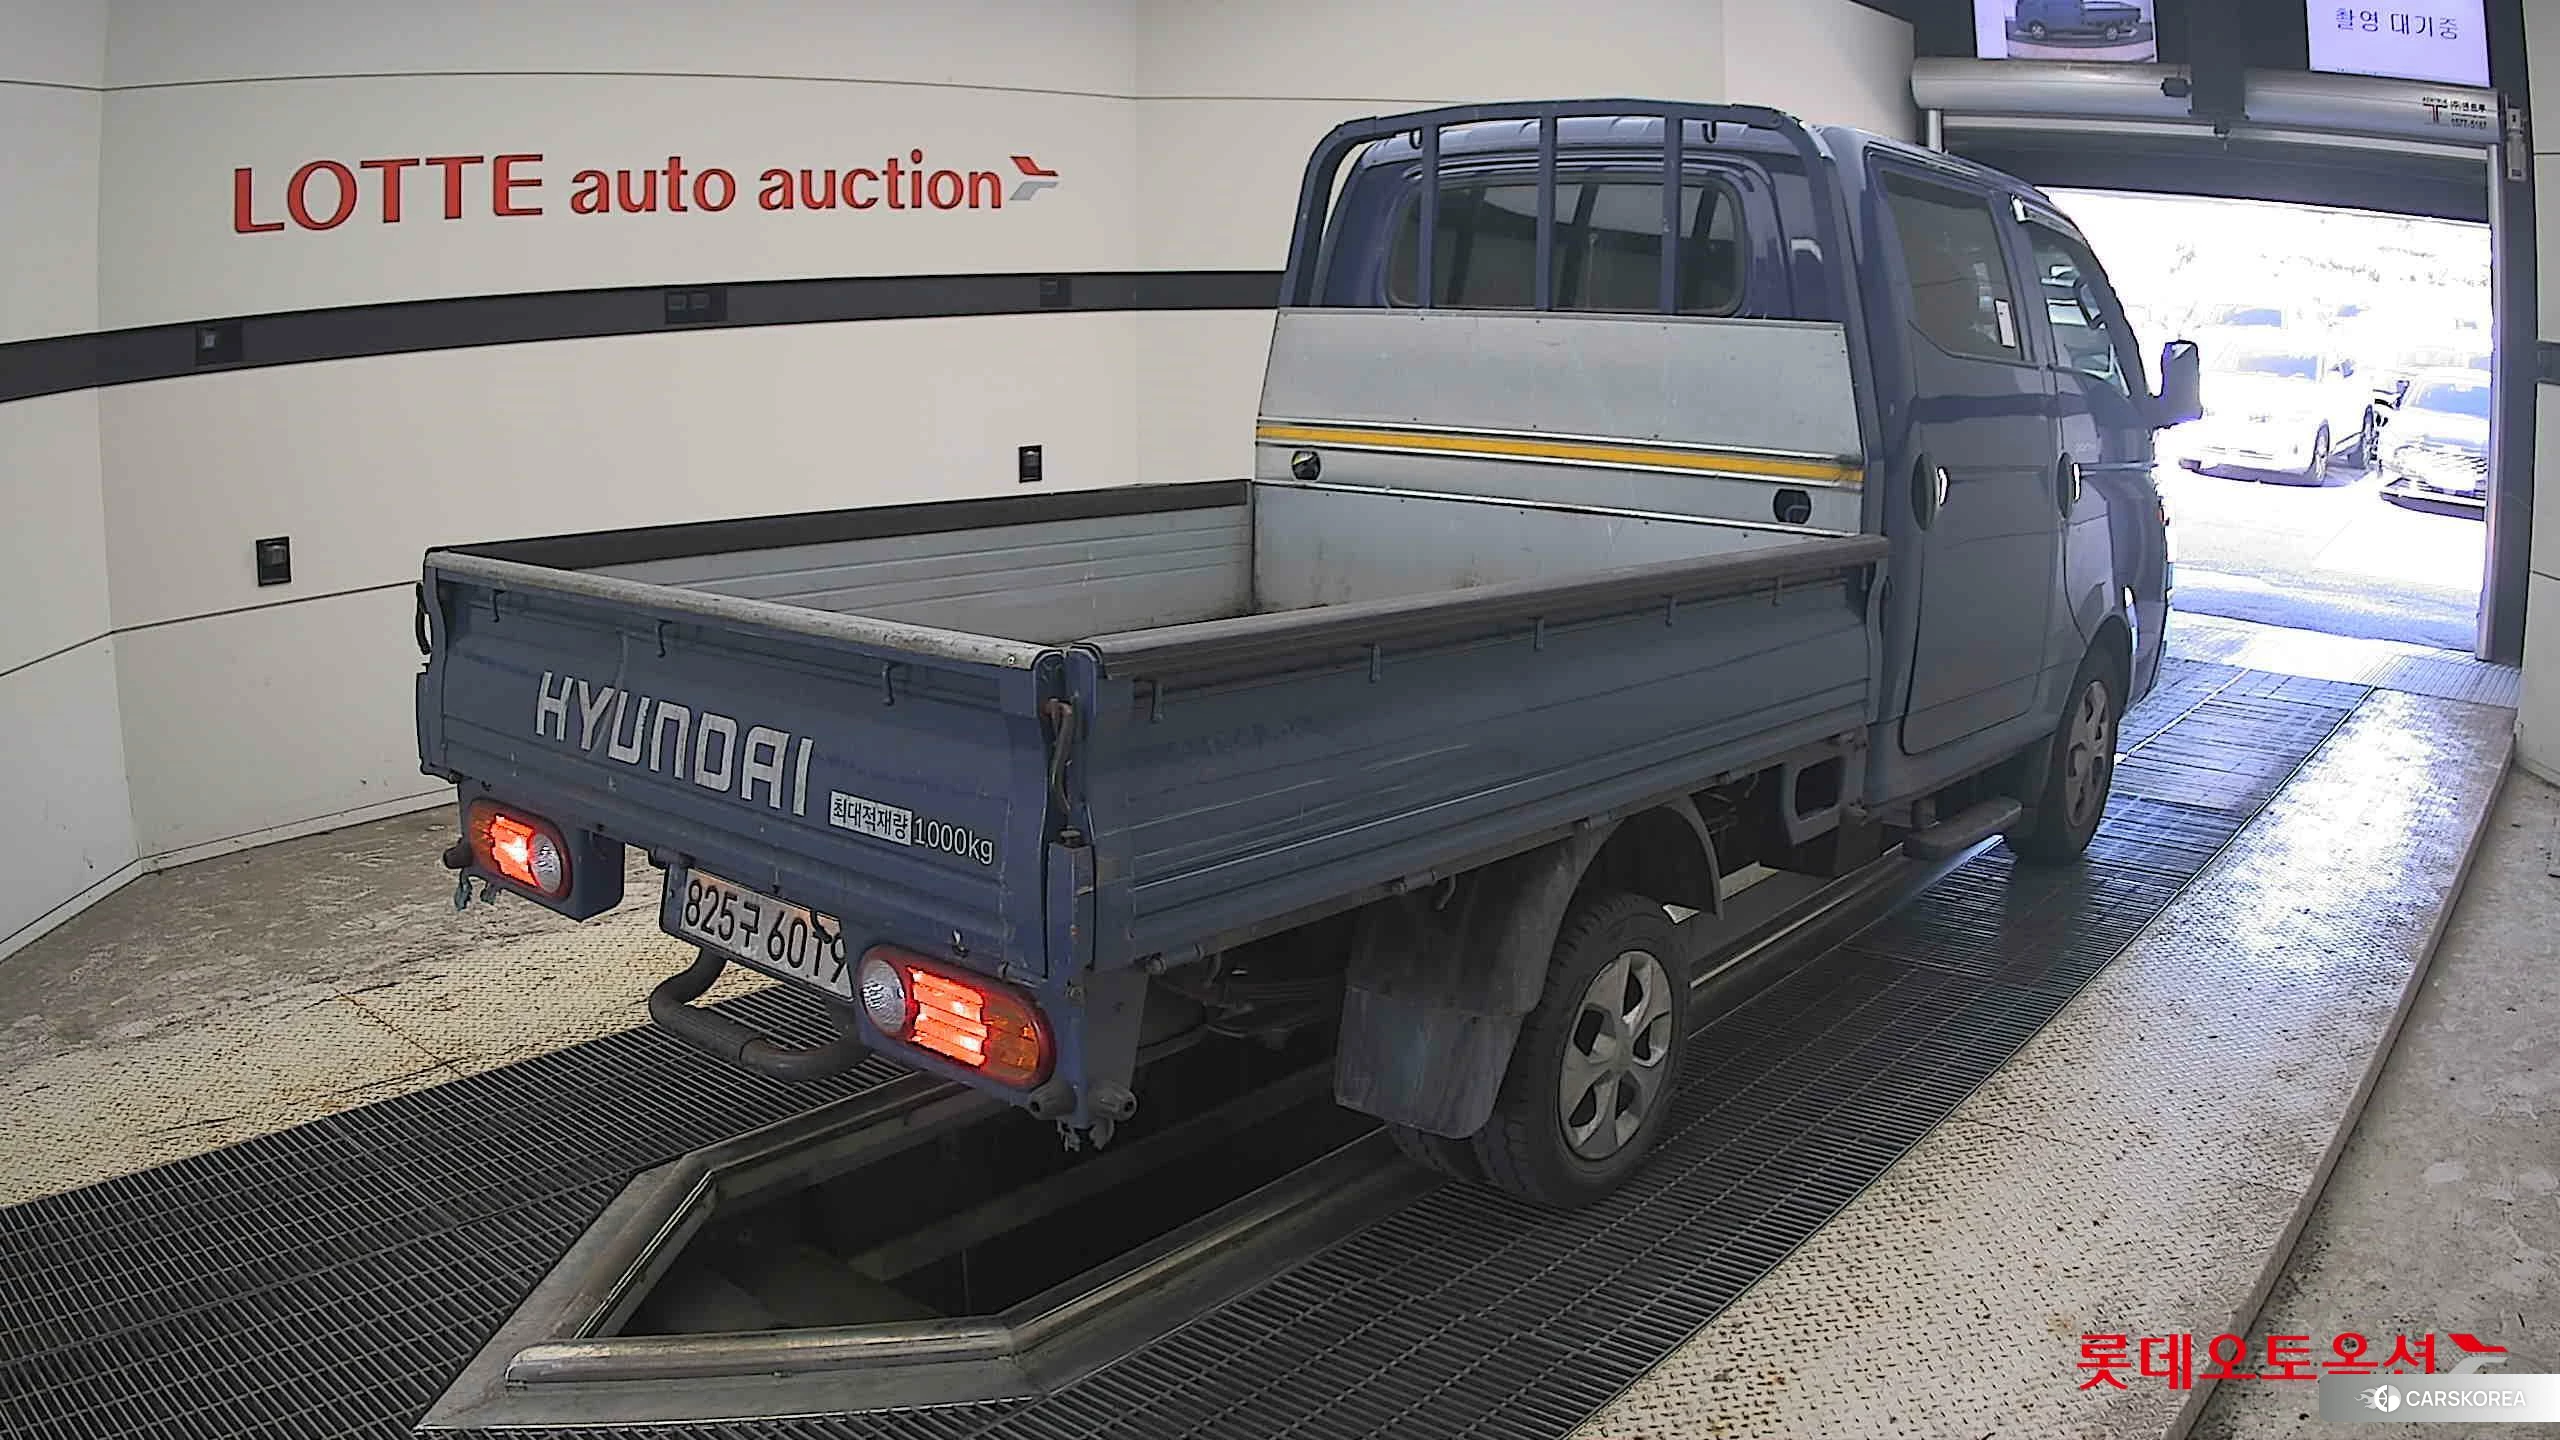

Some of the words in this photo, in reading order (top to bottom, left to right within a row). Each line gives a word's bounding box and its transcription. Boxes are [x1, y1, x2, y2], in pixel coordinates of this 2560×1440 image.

[2336, 7, 2378, 32] 촬영
[2391, 13, 2457, 40] 대기중
[234, 154, 543, 234] LOTTE
[569, 155, 736, 213] auto
[757, 148, 1002, 211] auction
[535, 671, 814, 816] HYUNDAI
[832, 797, 909, 841] 최대적재량
[685, 879, 761, 948] 825구
